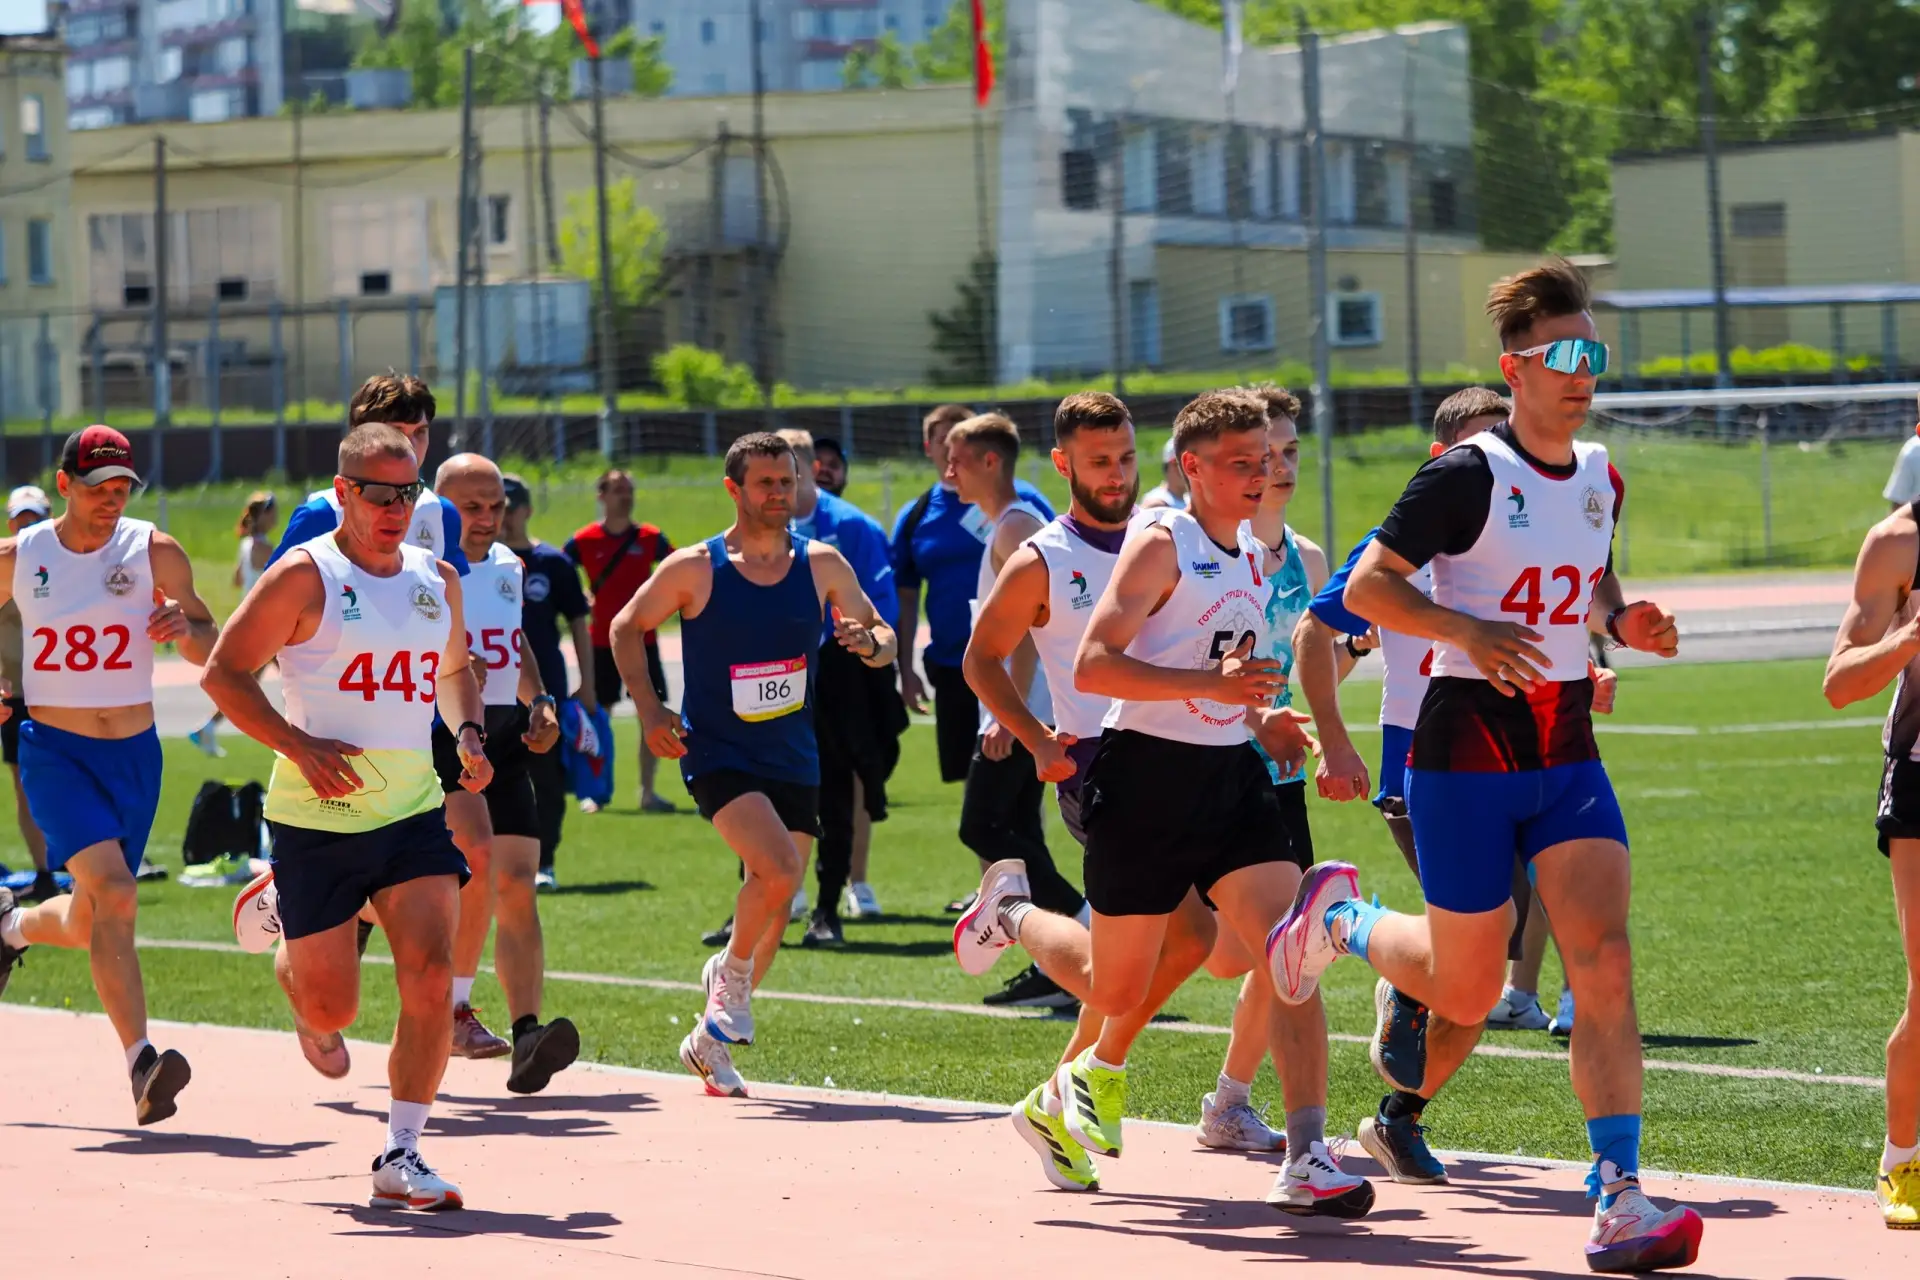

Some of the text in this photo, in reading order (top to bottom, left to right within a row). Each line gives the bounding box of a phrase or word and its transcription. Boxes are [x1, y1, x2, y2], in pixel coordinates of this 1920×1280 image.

[1197, 601, 1222, 626] ГОТОВ
[32, 624, 132, 672] 282
[338, 650, 440, 703] 443
[758, 679, 791, 702] 186
